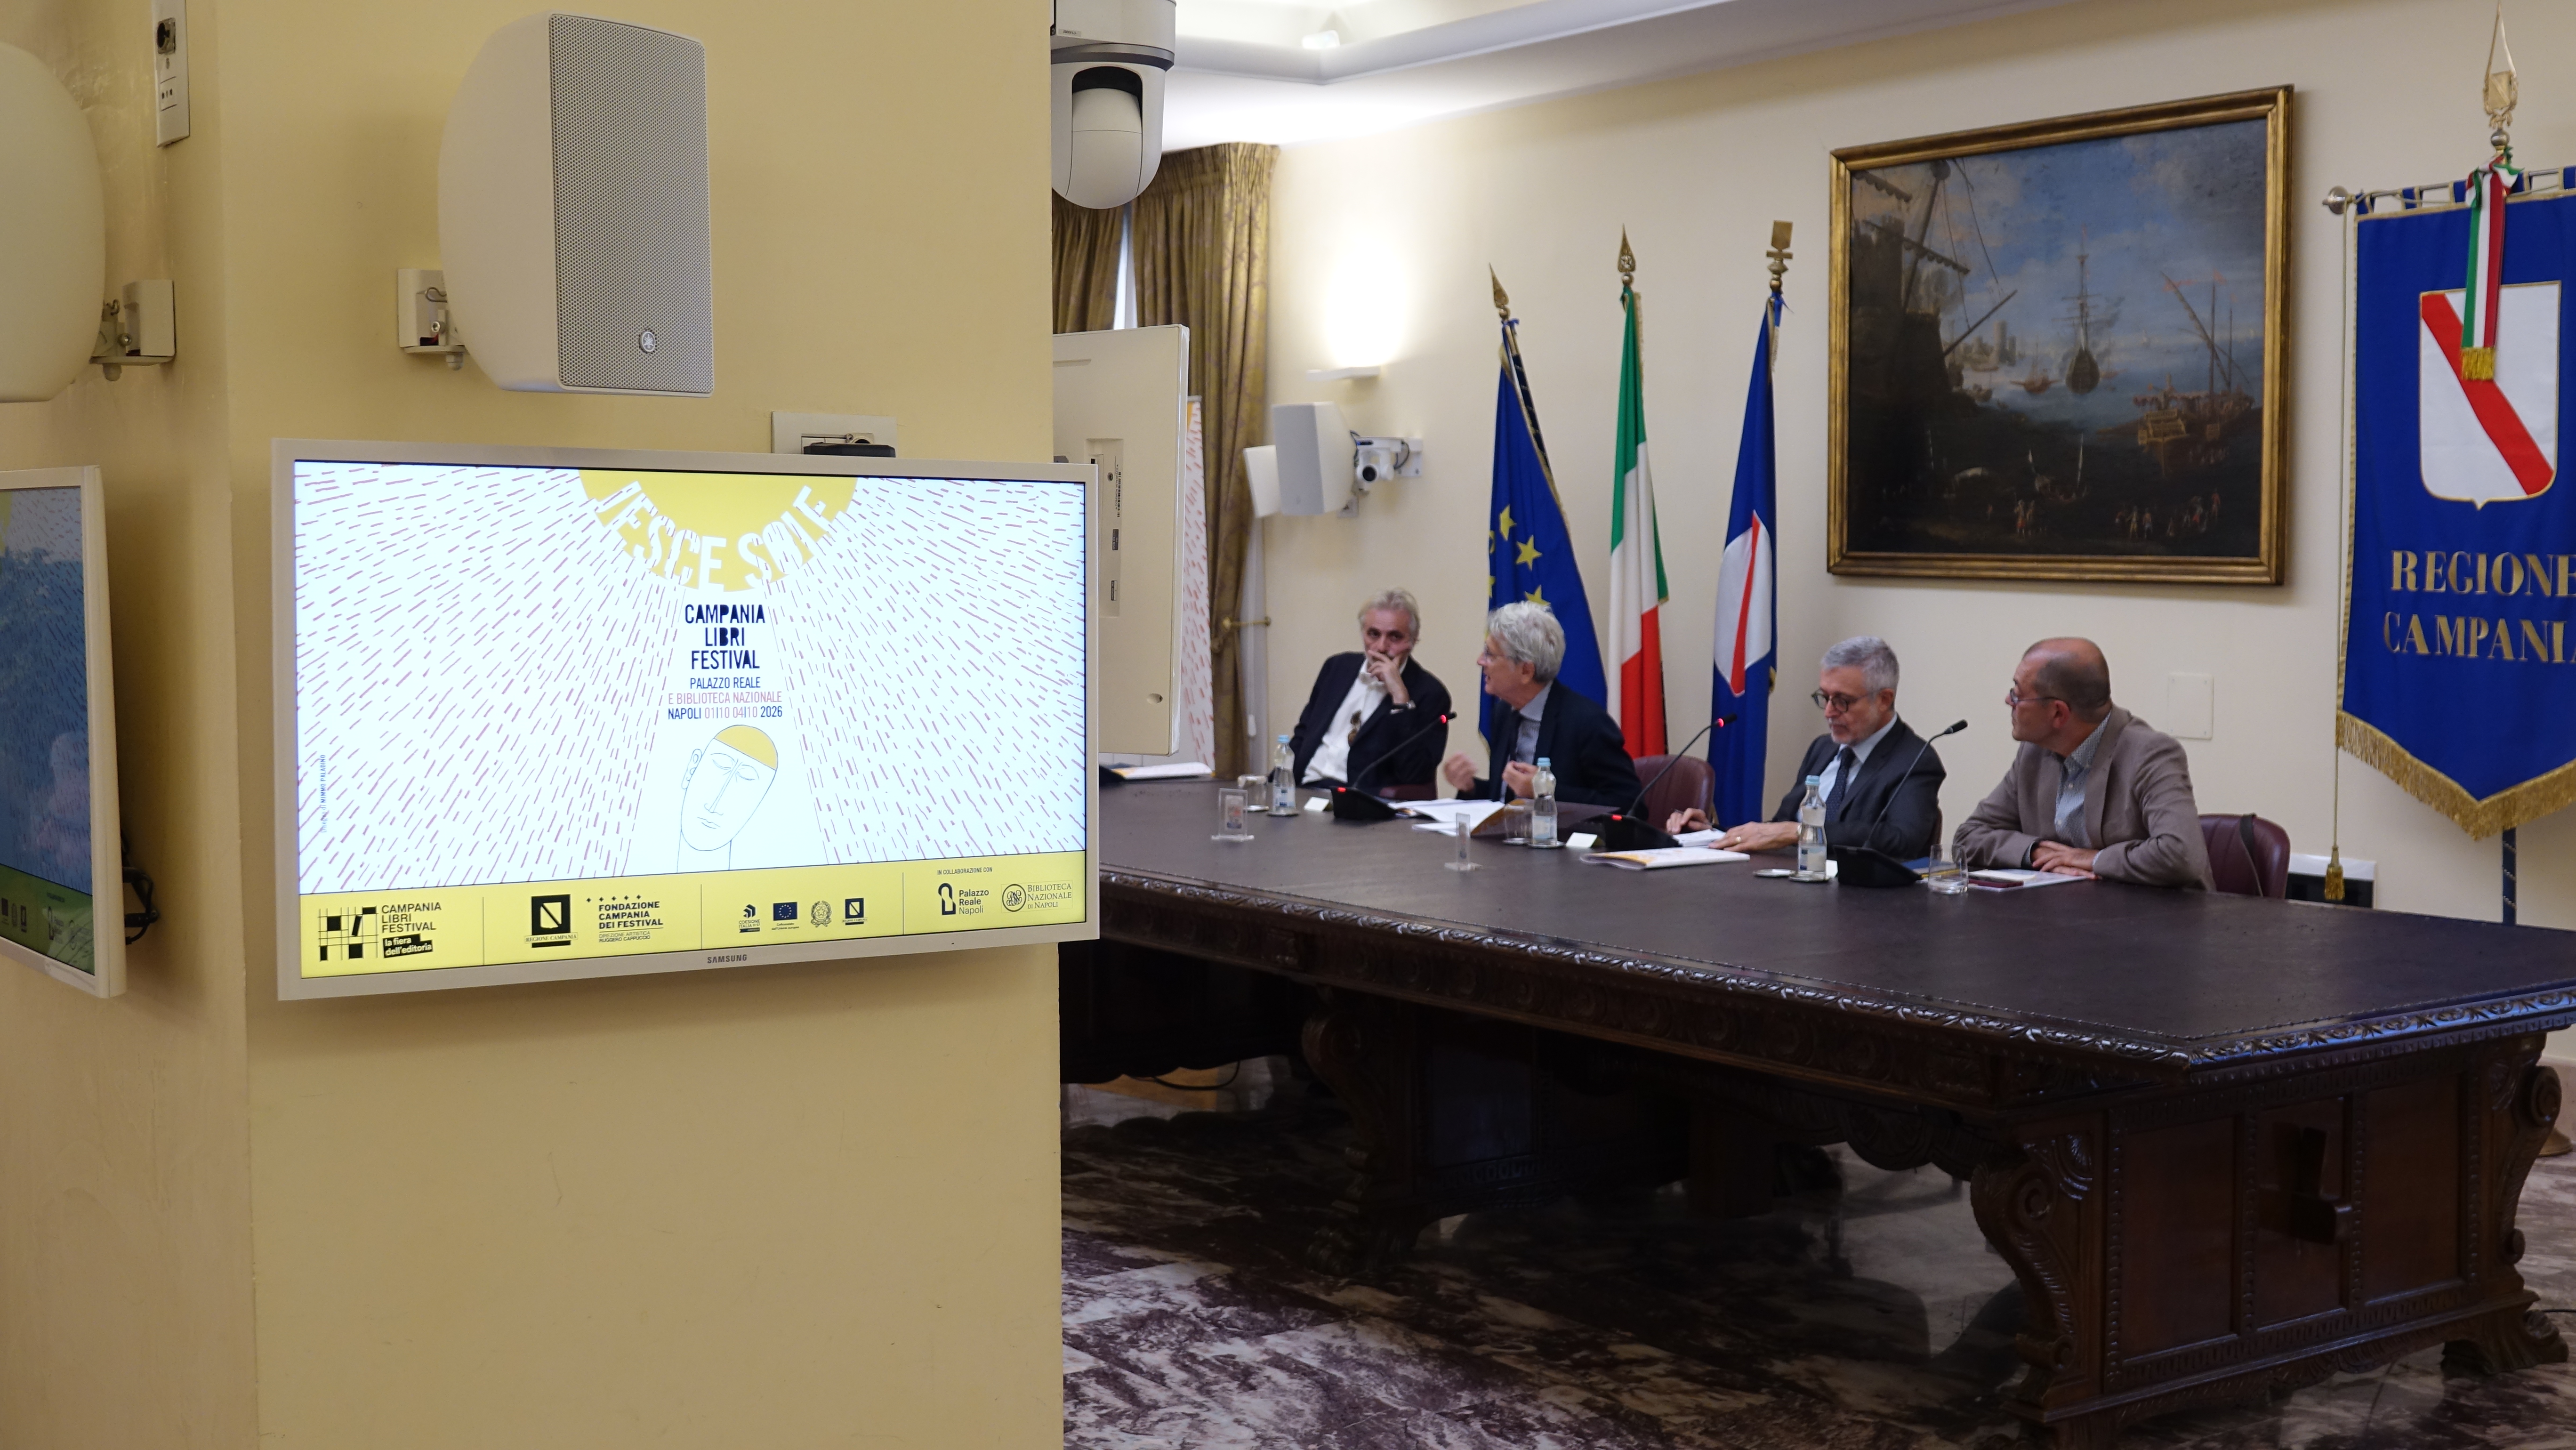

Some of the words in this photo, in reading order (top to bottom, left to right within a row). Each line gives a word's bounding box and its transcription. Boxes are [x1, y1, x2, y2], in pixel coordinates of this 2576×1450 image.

[738, 485, 845, 589] SOLE
[2391, 550, 2576, 597] REGIONE
[685, 604, 765, 624] CAMPANIA
[705, 627, 745, 646] LIBRI
[2383, 612, 2576, 664] CAMPANI
[692, 650, 760, 669] FESTIVAL
[690, 677, 730, 689] PALAZZO
[733, 677, 761, 688] REALE
[668, 693, 674, 704] E
[676, 692, 731, 704] BIBLIOTECA
[733, 691, 782, 703] NAZIONALE
[668, 708, 701, 719] NAPOLI
[760, 706, 782, 717] 2026
[959, 889, 989, 897] Palazzo
[1028, 883, 1072, 892] BIBLIOTECA
[1028, 892, 1072, 901] NAZIONALE
[382, 902, 442, 914] CAMPANIA
[599, 901, 660, 912] FONDAZIONE
[959, 905, 983, 916] Napoli
[382, 914, 412, 924] LIBRI
[599, 910, 650, 920] CAMPANIA
[382, 922, 437, 933] FESTIVAL
[599, 921, 615, 929] DEI
[618, 918, 663, 928] FESTIVAL
[385, 939, 392, 947] la
[393, 937, 411, 945] fiera
[385, 943, 432, 956] dell'editoria
[707, 954, 747, 964] SAMSUNG
